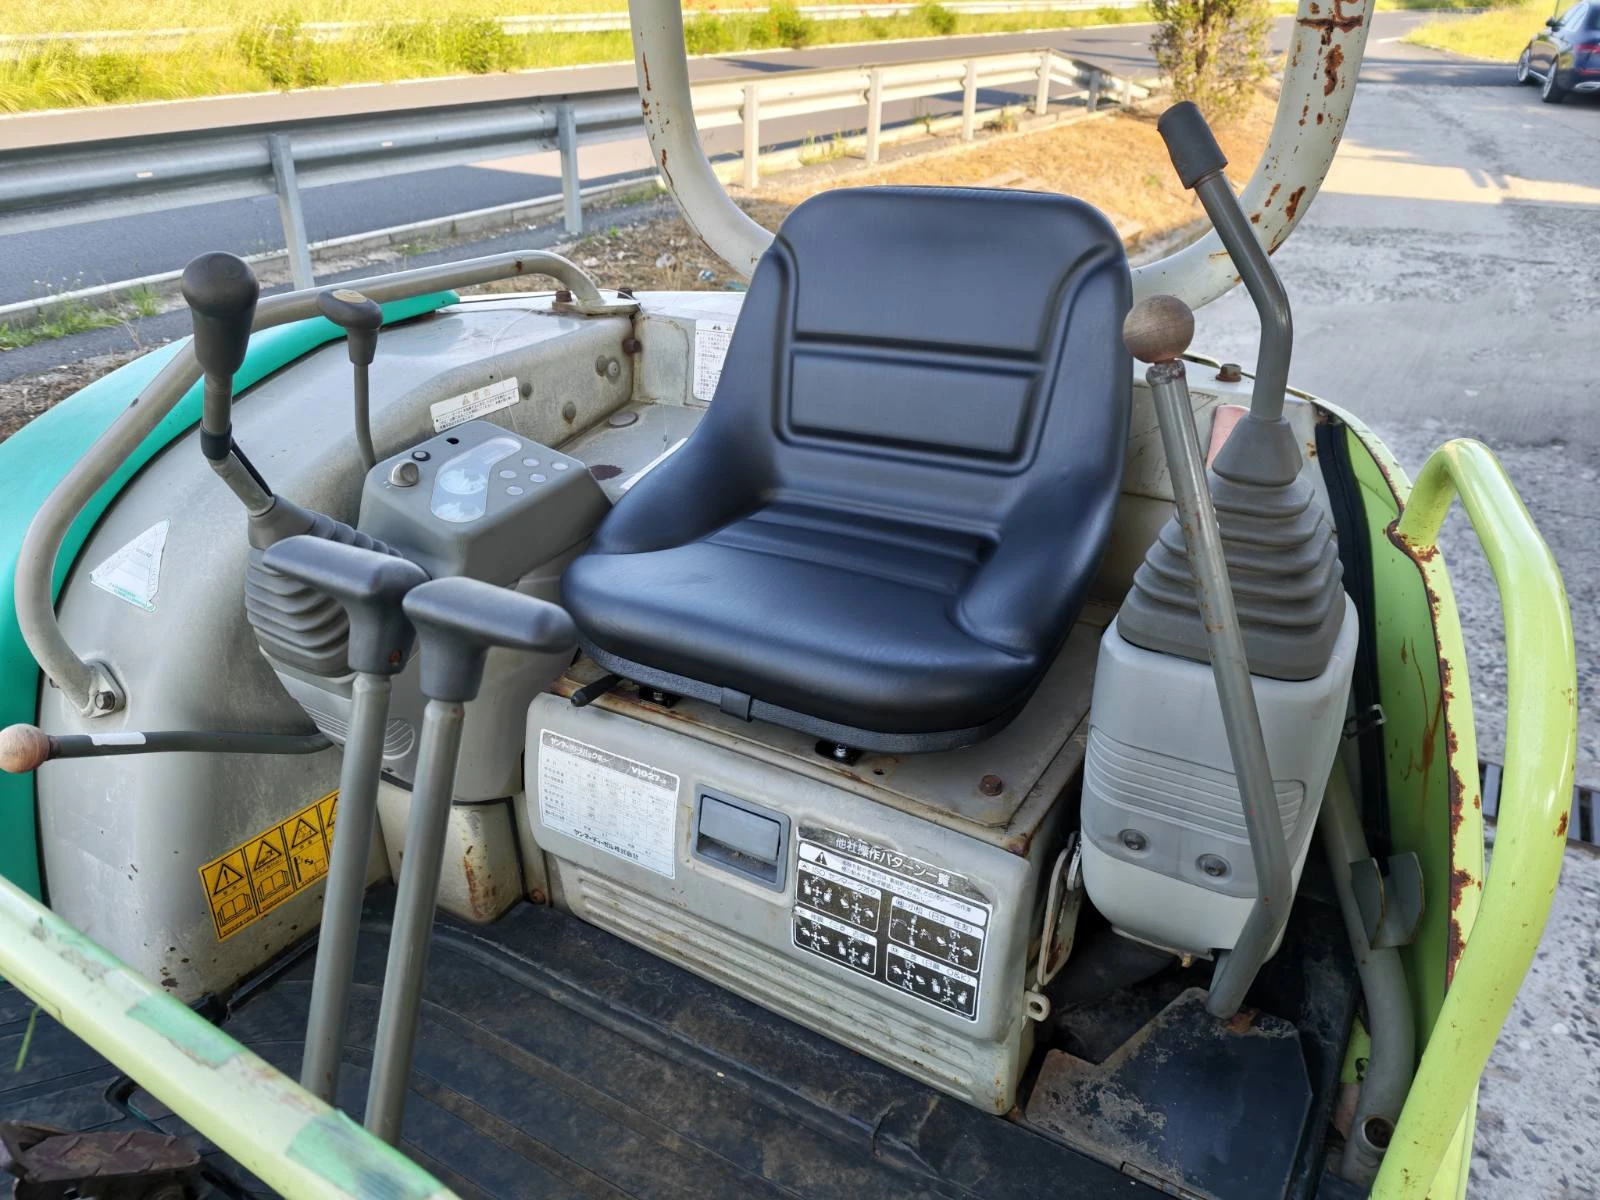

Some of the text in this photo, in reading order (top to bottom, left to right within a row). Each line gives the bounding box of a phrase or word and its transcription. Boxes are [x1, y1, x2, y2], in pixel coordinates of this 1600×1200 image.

[835, 837, 951, 887] 他社操作パターン一覧
